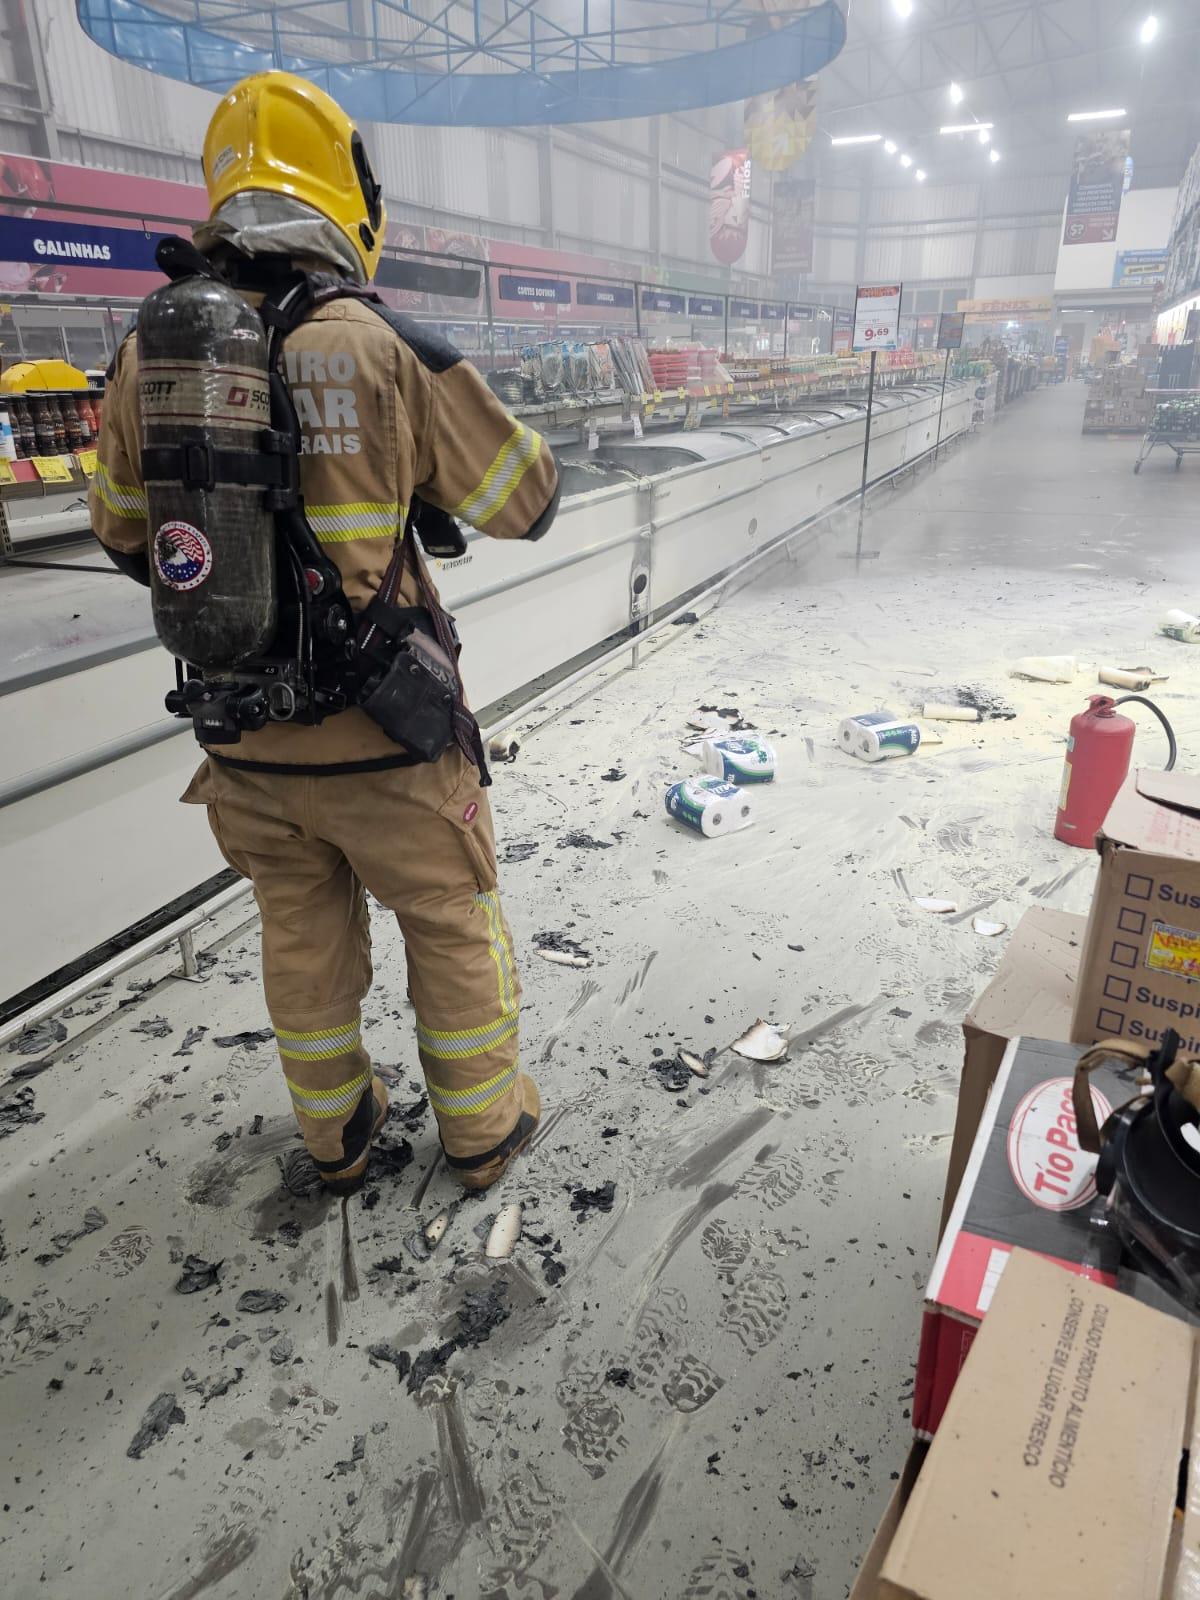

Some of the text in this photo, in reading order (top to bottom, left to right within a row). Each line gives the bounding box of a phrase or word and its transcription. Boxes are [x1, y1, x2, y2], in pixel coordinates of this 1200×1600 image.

[33, 238, 112, 260] GALINHAS
[140, 381, 176, 395] COTT
[277, 352, 356, 385] IRO
[292, 388, 360, 428] AR
[1086, 1303, 1109, 1349] CUIDADO
[1023, 1297, 1084, 1467] CONSERVE EM LUGAR FRESCO
[1071, 1348, 1098, 1402] PRODUTO
